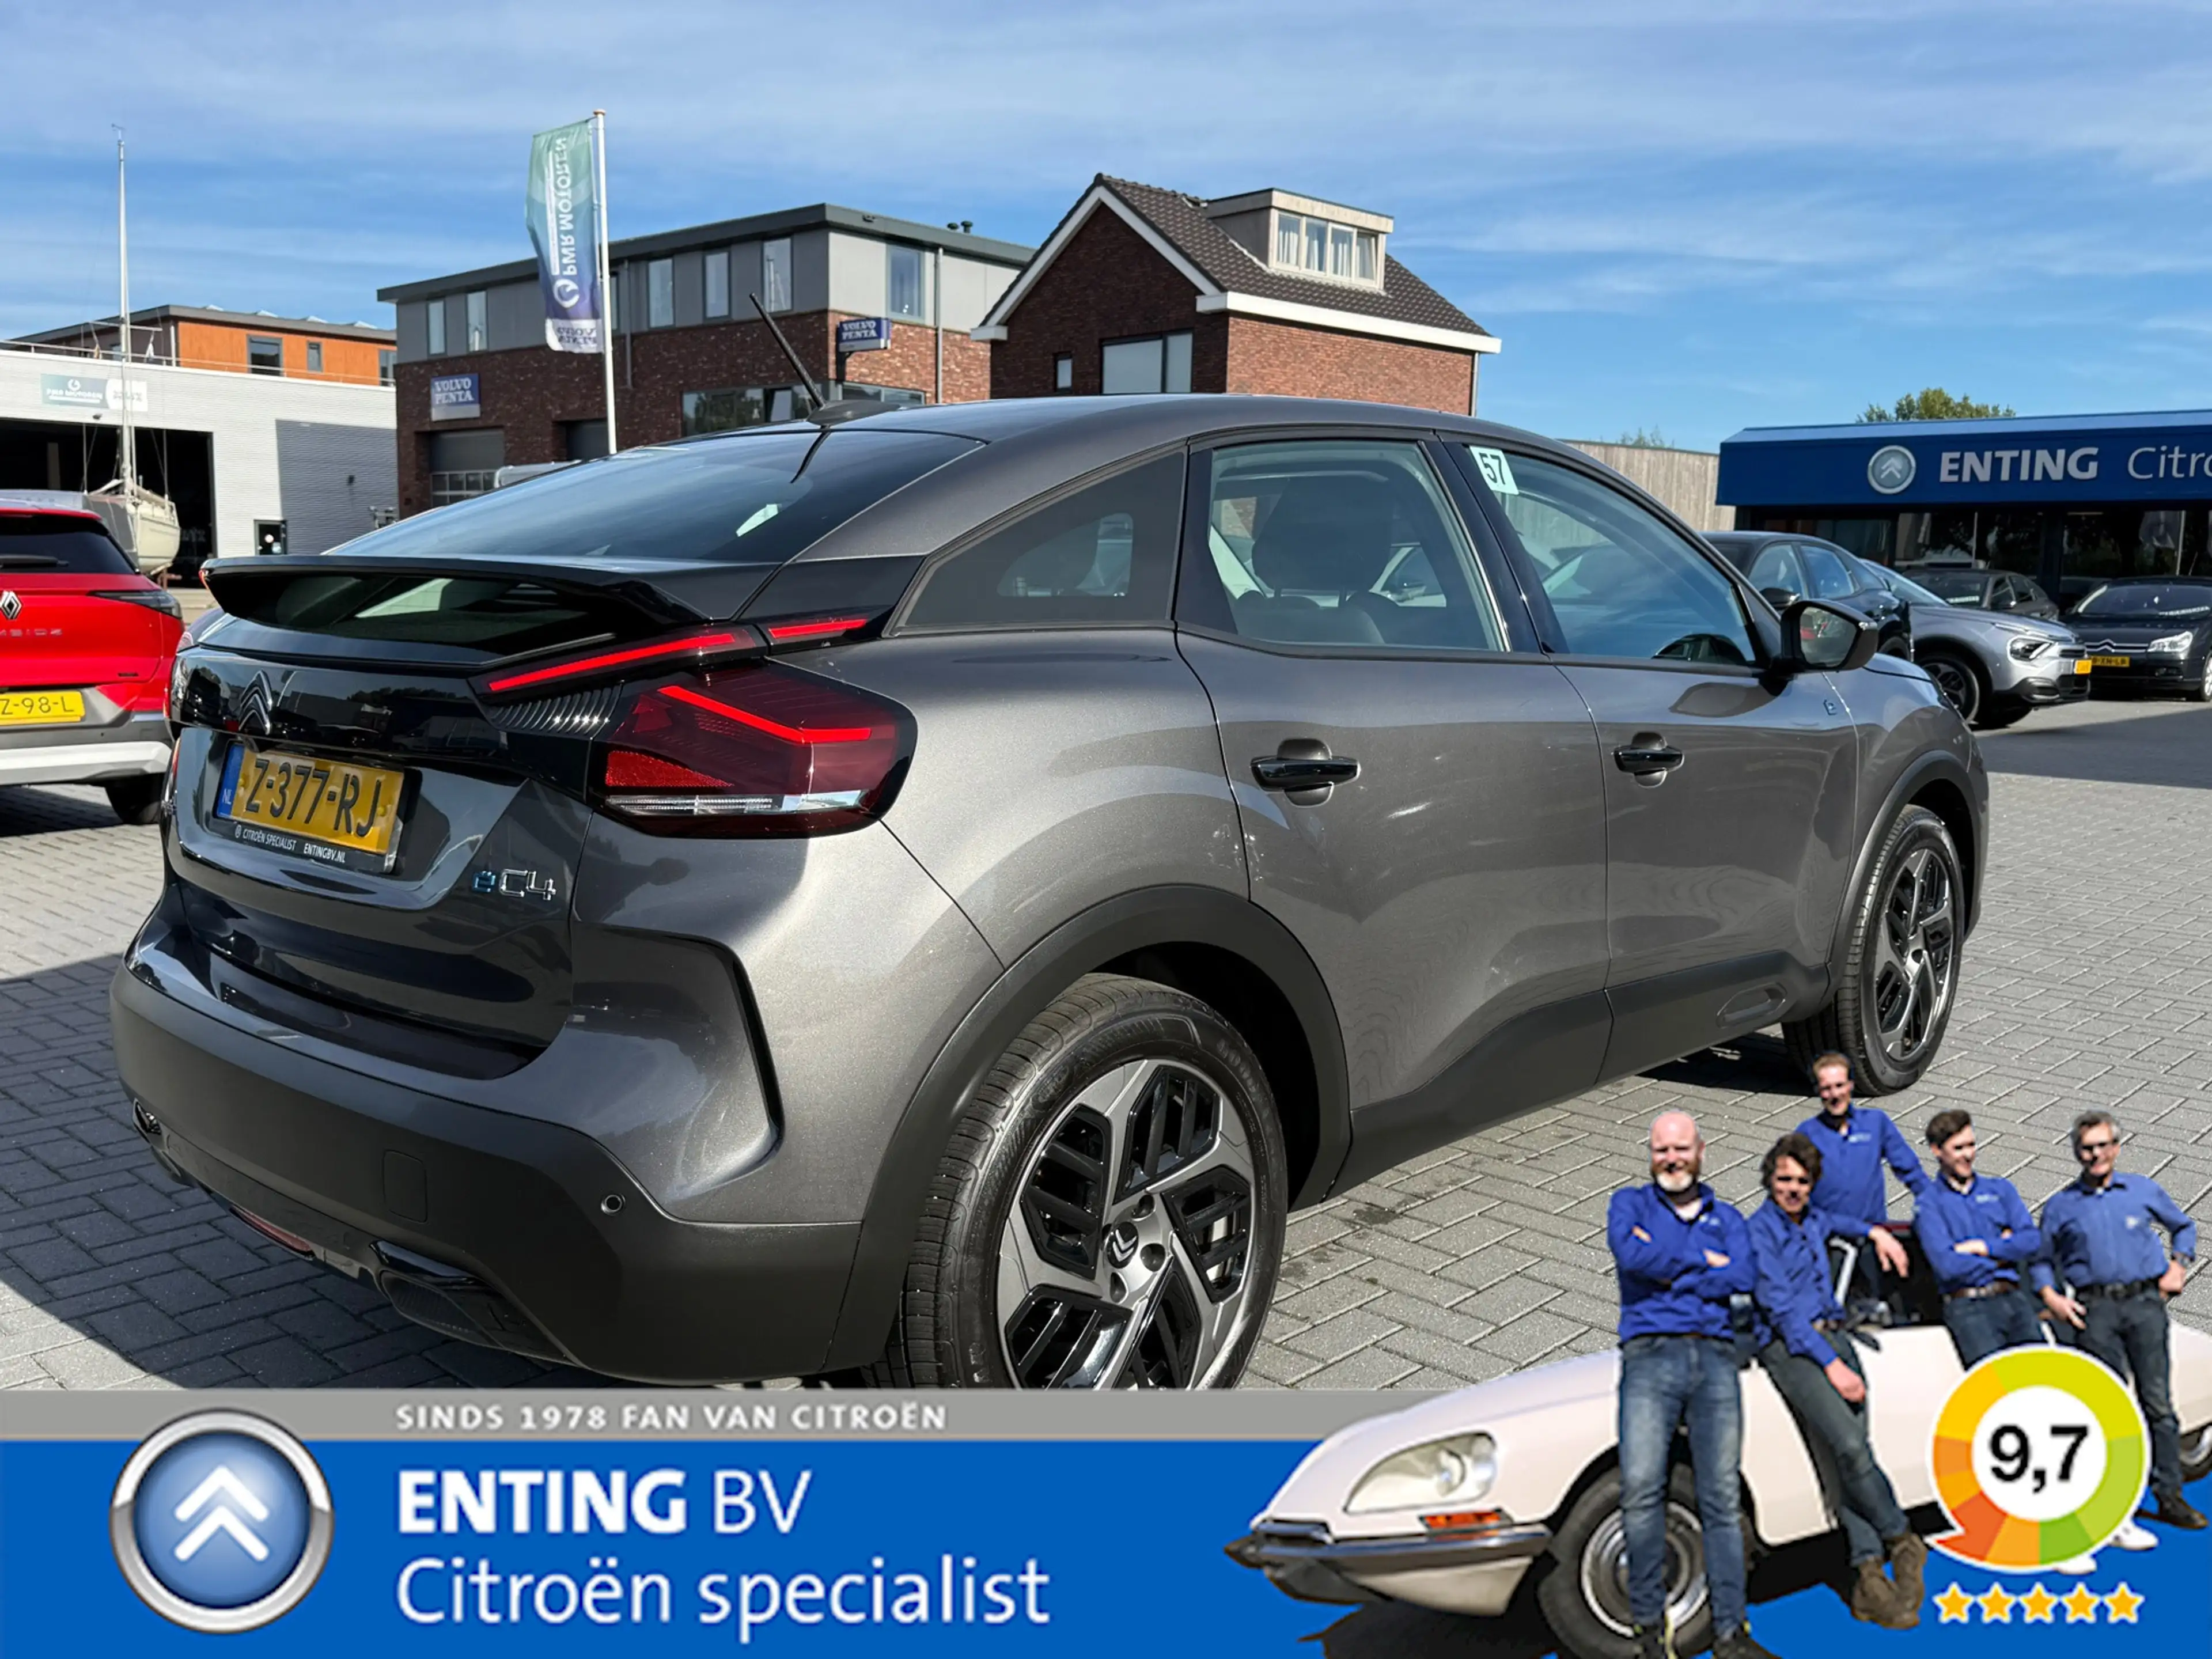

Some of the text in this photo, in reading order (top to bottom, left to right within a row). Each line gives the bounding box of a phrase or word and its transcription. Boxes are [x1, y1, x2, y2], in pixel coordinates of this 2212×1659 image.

[842, 320, 877, 331] VOLVO
[842, 329, 878, 340] PENTA
[434, 377, 472, 392] VOLVO
[434, 389, 475, 404] PENTA
[1478, 452, 1506, 485] 57
[1940, 448, 2099, 482] ENTING
[222, 788, 232, 805] NL
[245, 758, 382, 838] Z-377-RJ
[243, 828, 346, 863] CITROËN SPECIALIST ENTINGBV.NL
